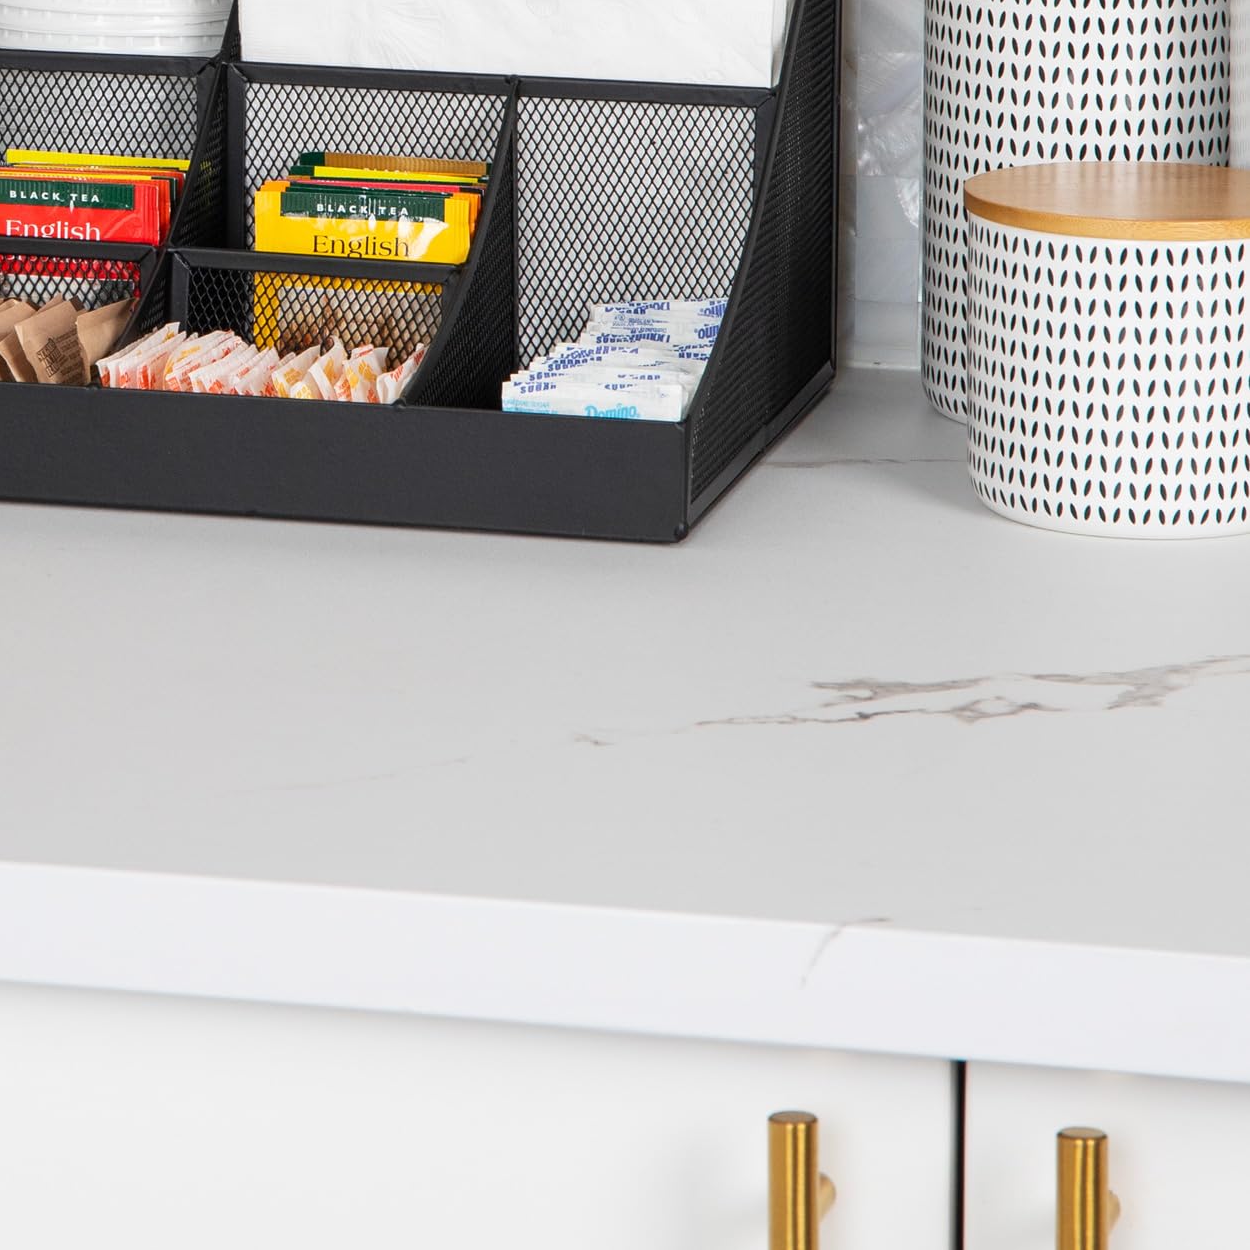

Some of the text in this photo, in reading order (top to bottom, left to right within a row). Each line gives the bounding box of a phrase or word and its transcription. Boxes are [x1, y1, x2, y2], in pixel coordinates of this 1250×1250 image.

[9, 190, 100, 203] BLACK TEA
[316, 203, 409, 216] BLACK TEA
[6, 219, 101, 241] English
[313, 234, 410, 259] English
